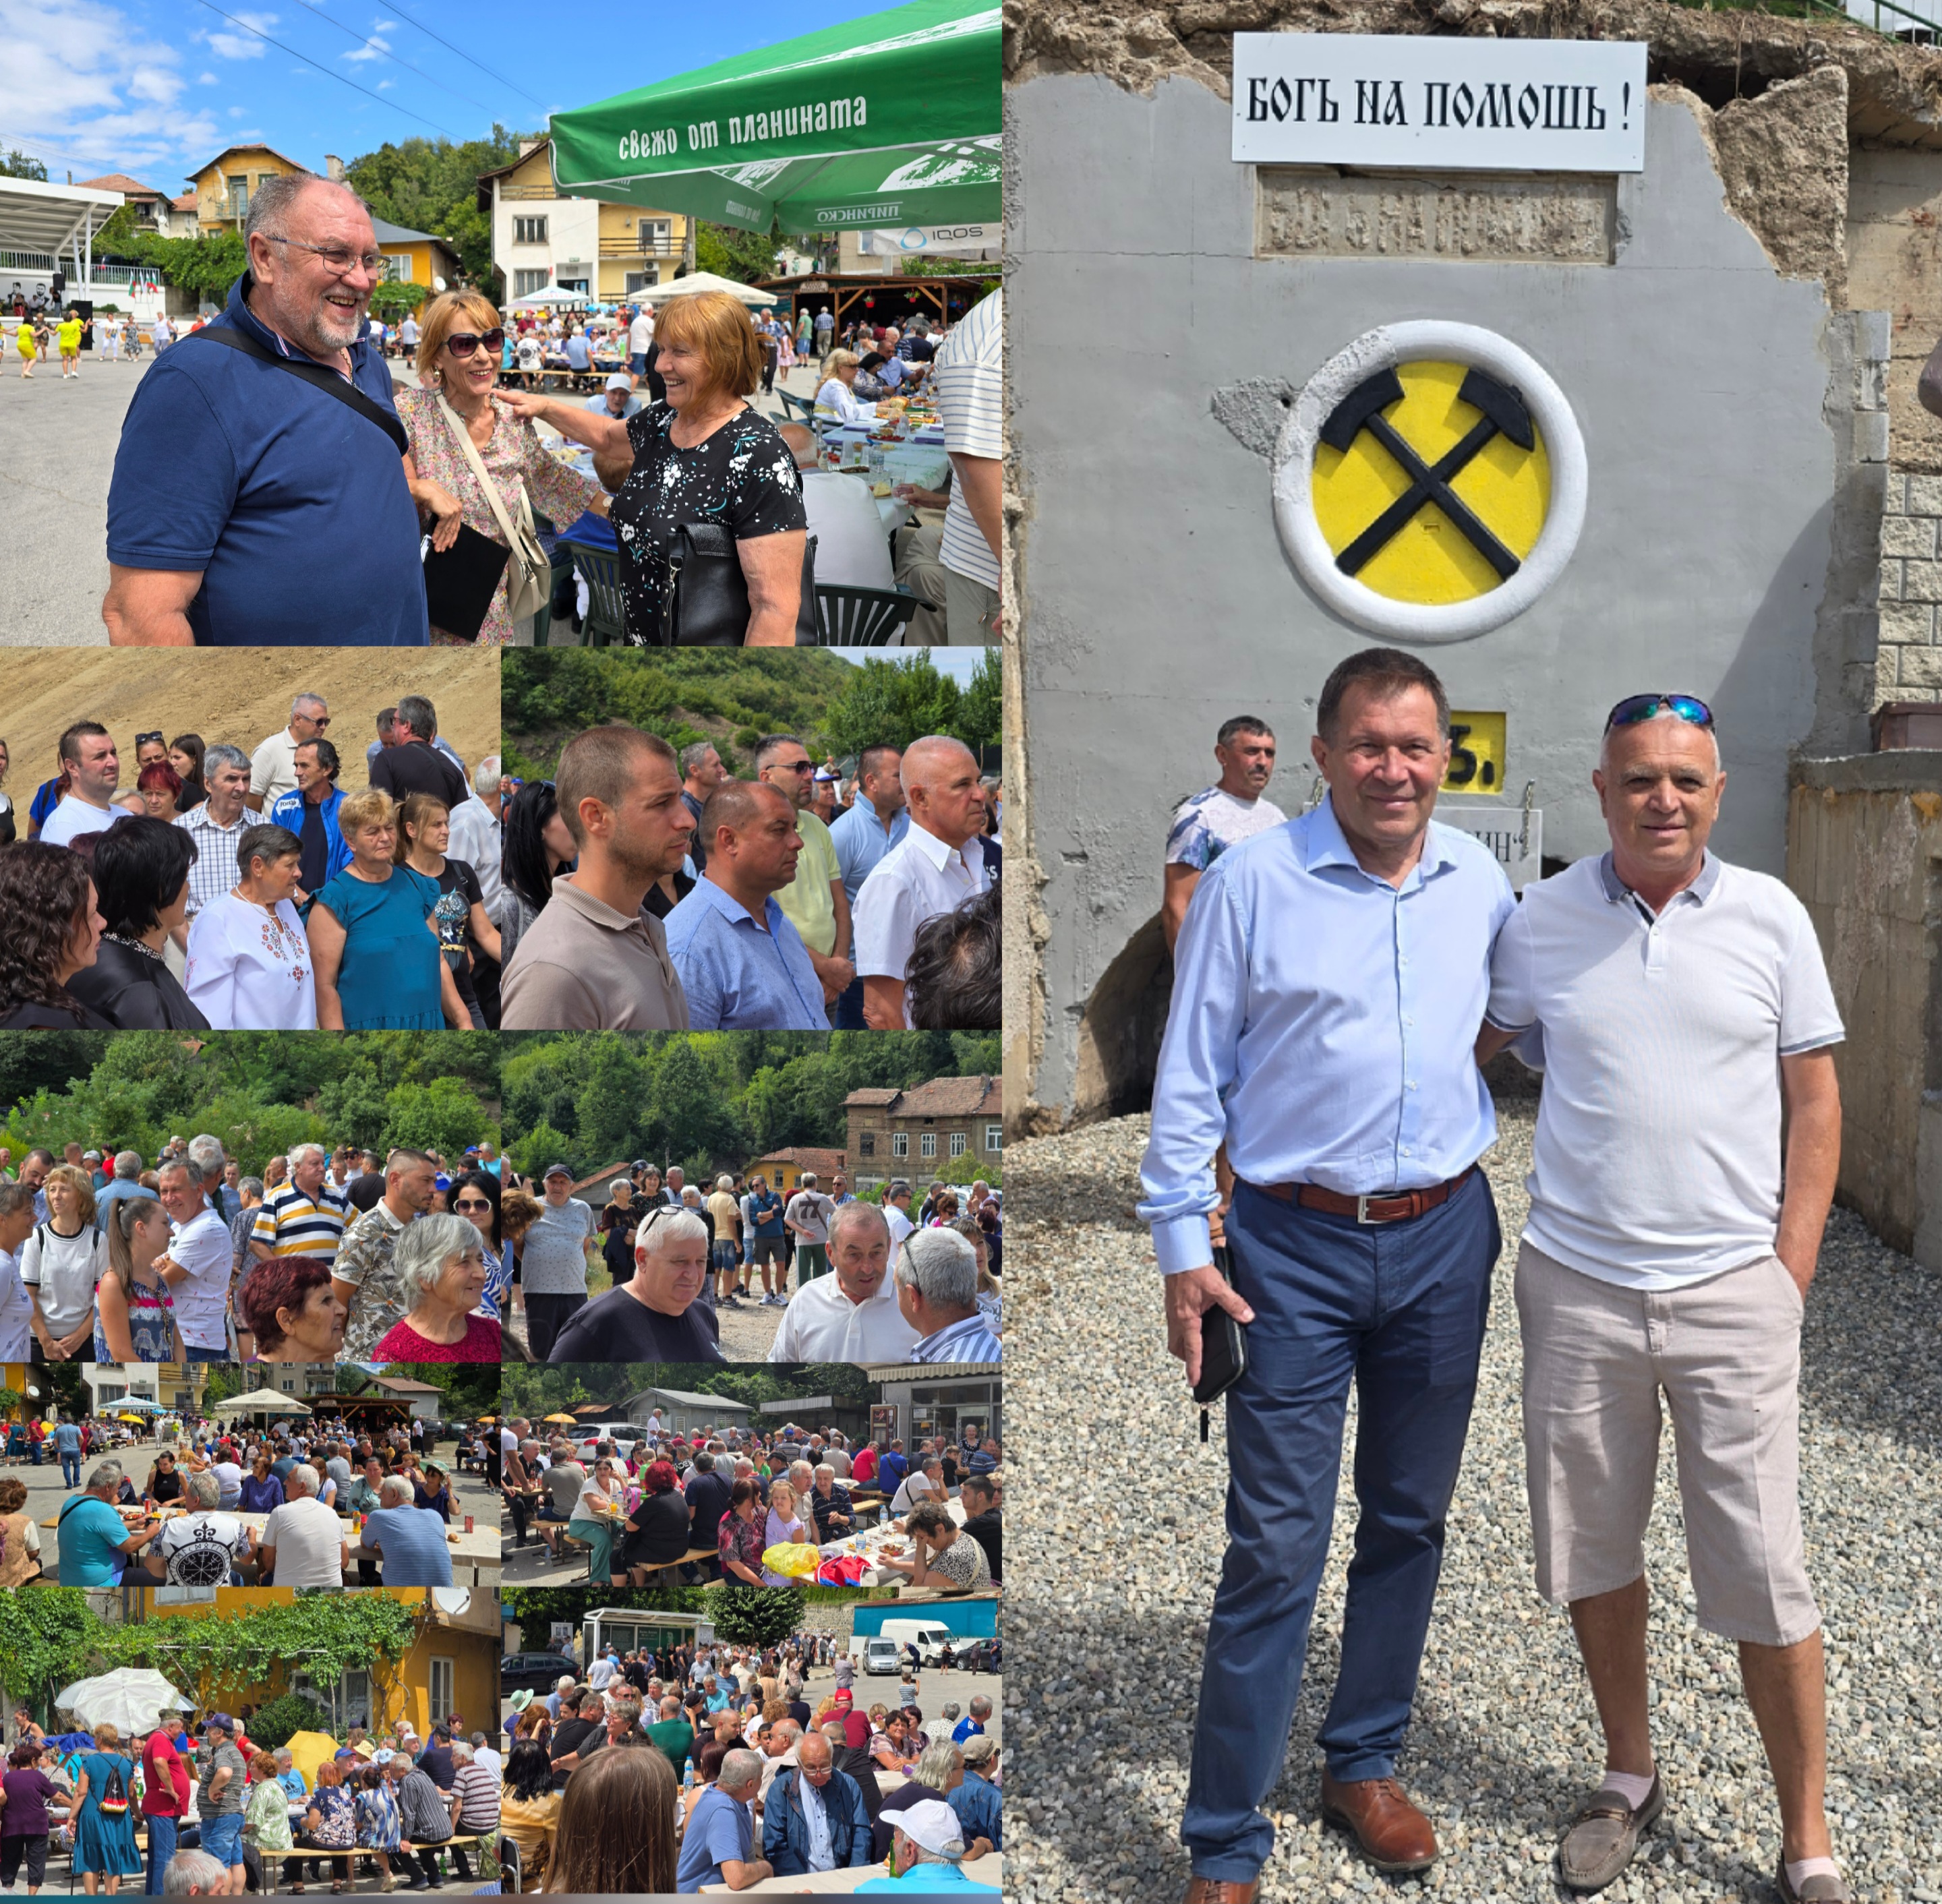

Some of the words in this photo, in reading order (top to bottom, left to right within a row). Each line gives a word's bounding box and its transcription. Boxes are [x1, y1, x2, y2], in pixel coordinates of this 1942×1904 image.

[1247, 76, 1339, 123] БОГЬ
[1354, 80, 1409, 125] НА
[1423, 82, 1606, 130] ПОМОШЬ
[618, 128, 678, 160] свежо
[688, 120, 719, 150] от
[728, 96, 866, 144] планината
[933, 226, 983, 241] IQOS
[798, 1199, 821, 1220] 77
